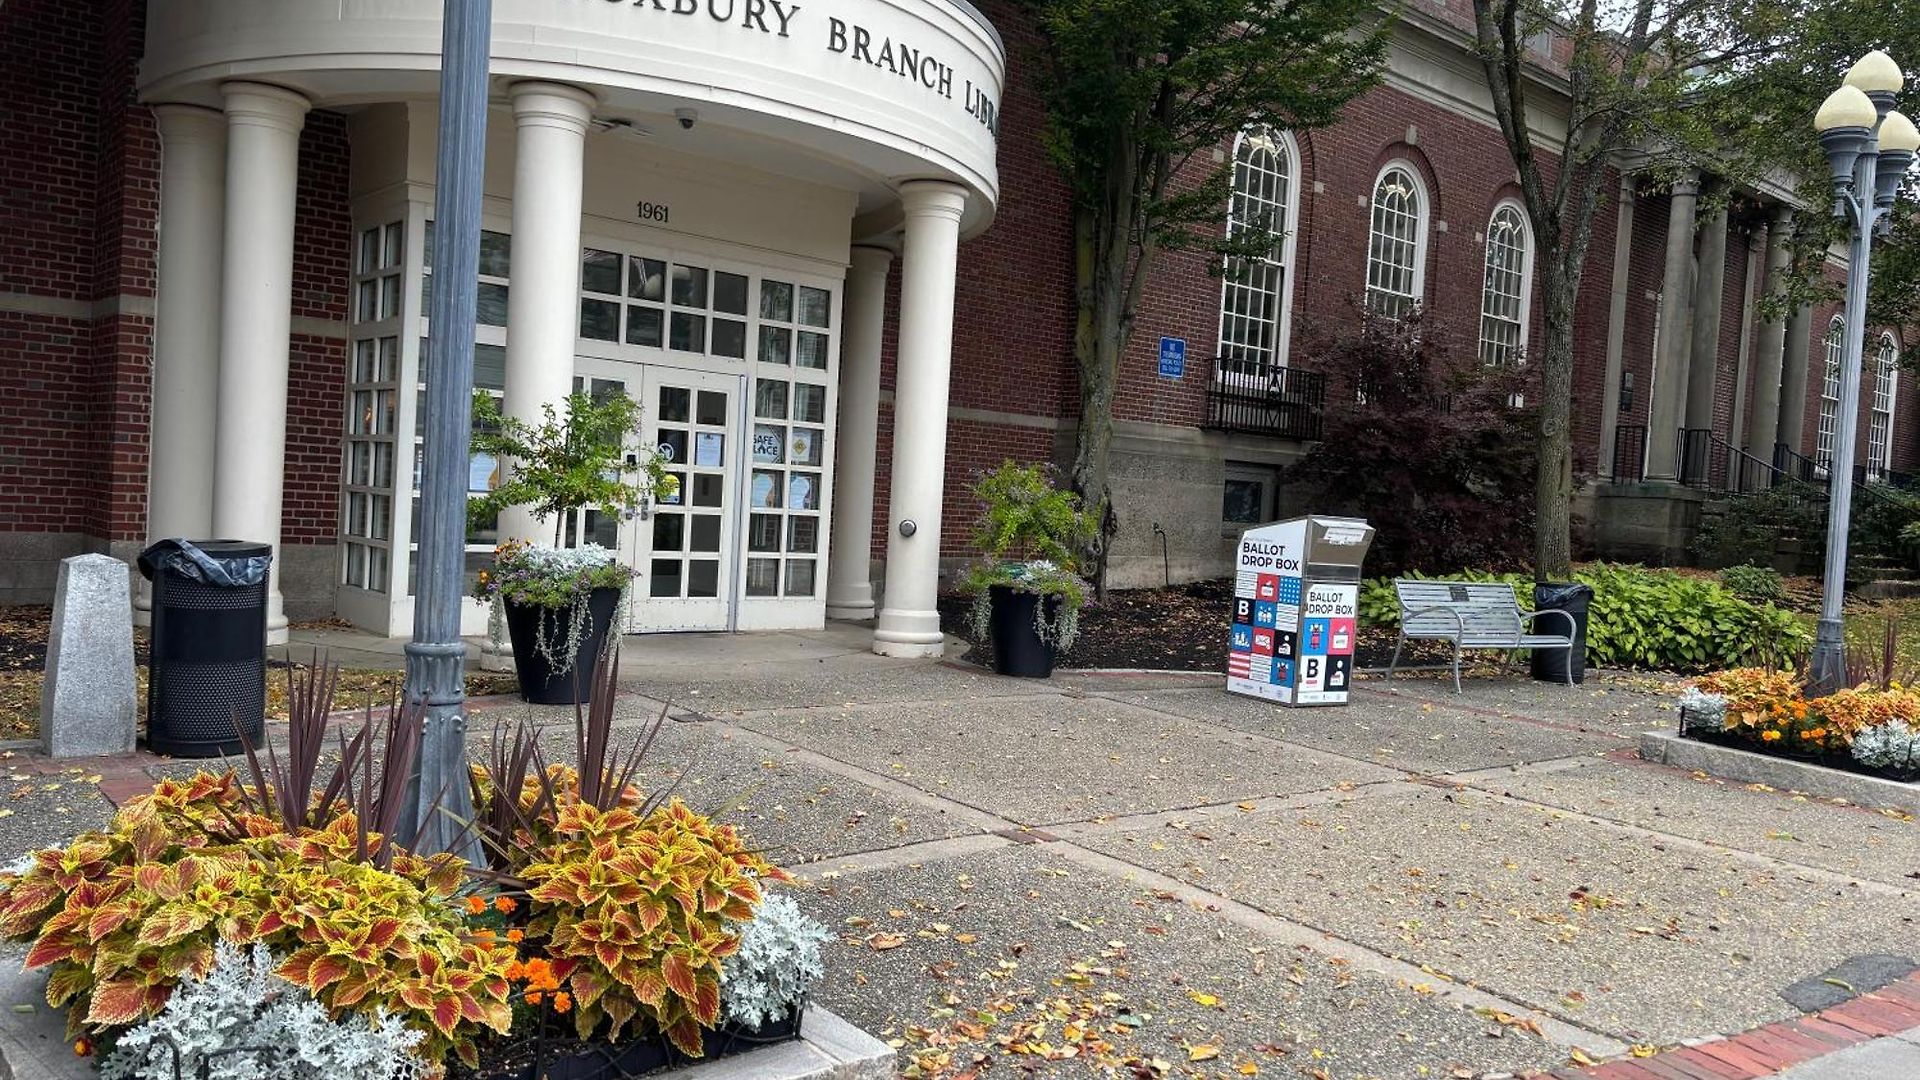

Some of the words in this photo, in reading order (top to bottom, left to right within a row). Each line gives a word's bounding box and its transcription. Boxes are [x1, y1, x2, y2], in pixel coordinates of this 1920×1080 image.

[827, 16, 954, 100] BRANCH
[965, 79, 1000, 142] LIBR
[637, 200, 669, 222] 1961
[752, 445, 778, 455] LACE
[1243, 542, 1286, 556] BALLOT
[1242, 554, 1272, 567] DROP
[1275, 558, 1299, 571] BOX
[1310, 591, 1343, 603] BALLOT
[1238, 600, 1249, 616] B
[1308, 603, 1333, 614] DROP
[1335, 604, 1353, 615] BOX
[1306, 658, 1319, 678] B
